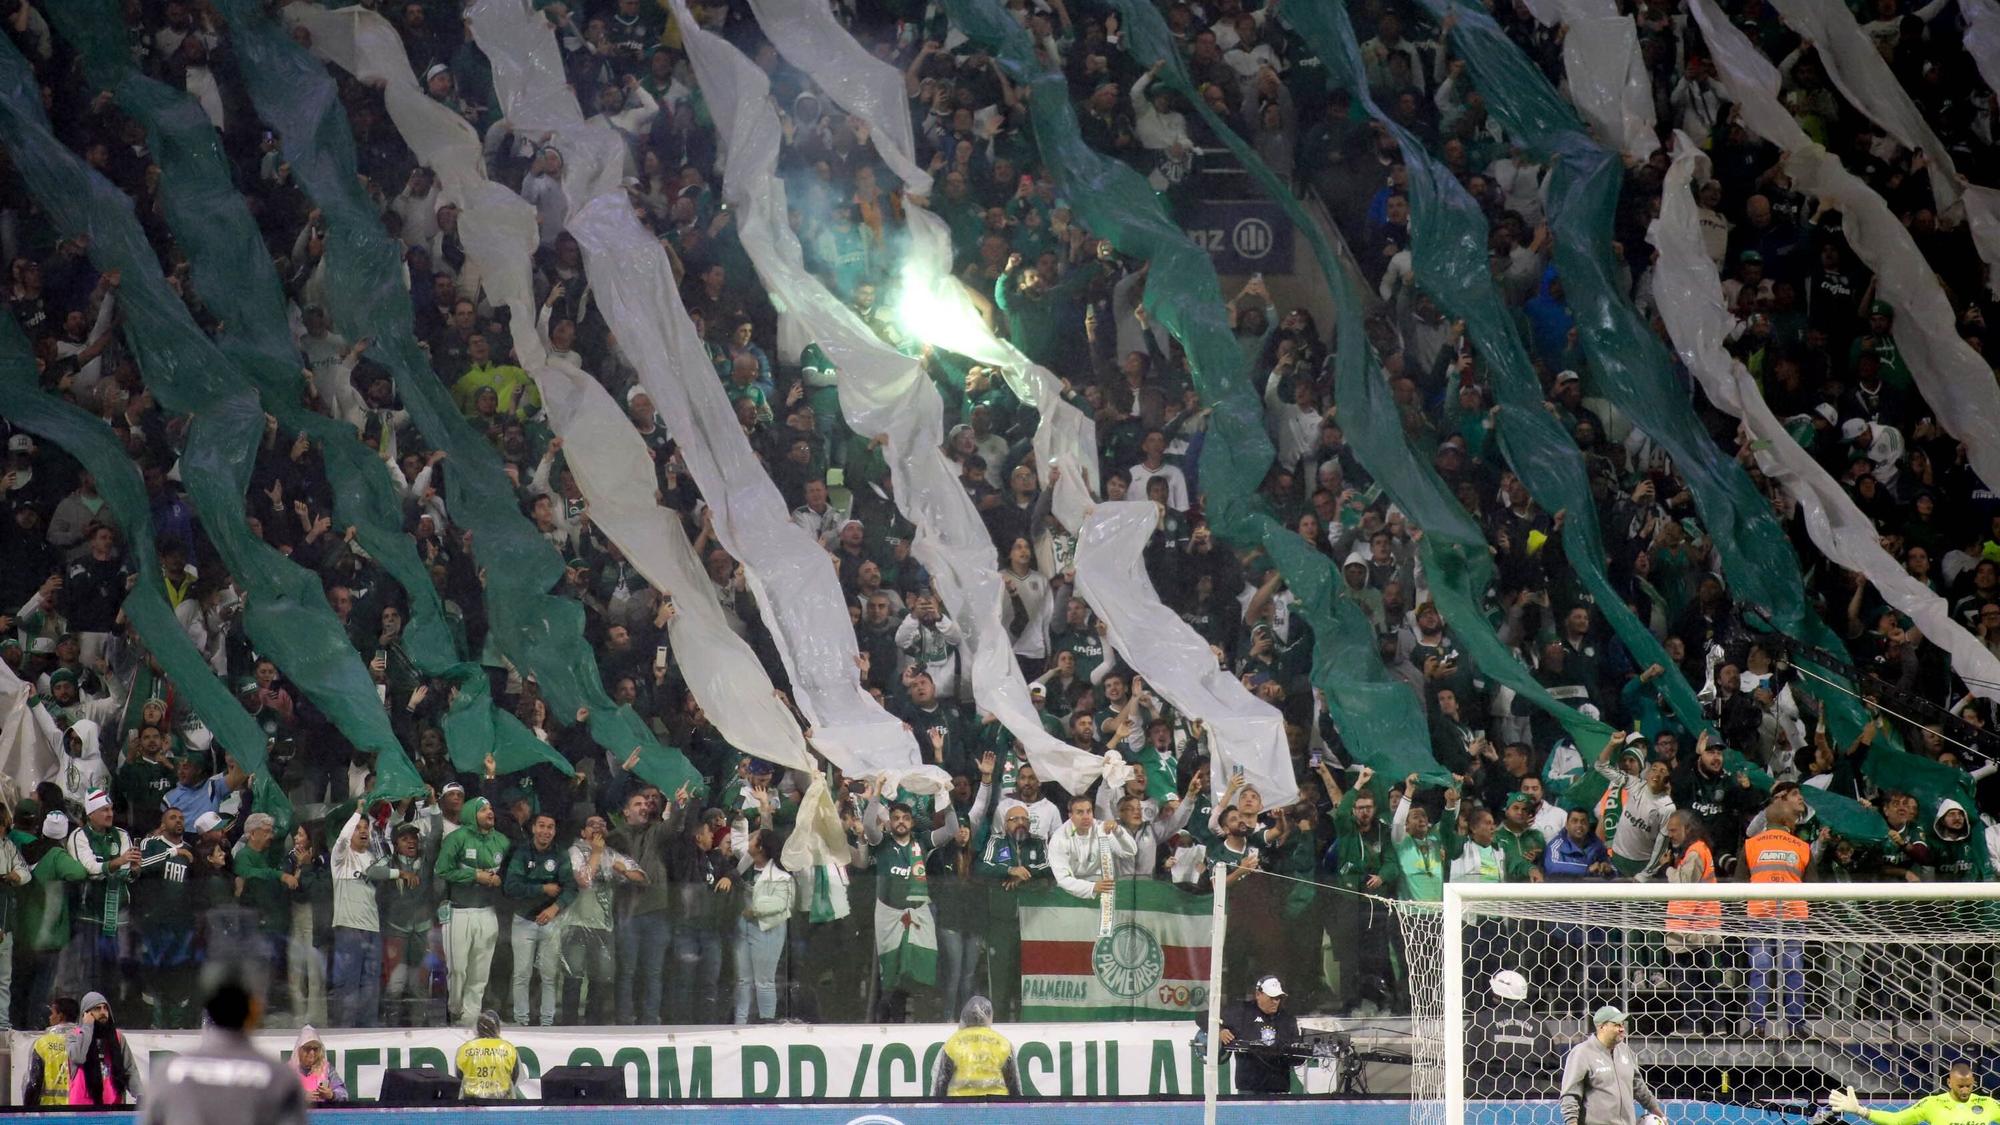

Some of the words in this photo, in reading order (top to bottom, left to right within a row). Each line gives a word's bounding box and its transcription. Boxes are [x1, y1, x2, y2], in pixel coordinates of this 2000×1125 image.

[1624, 810, 1652, 832] crefisa
[164, 861, 188, 883] FIAT
[1097, 951, 1159, 997] PALMEIRAS
[1022, 978, 1088, 1000] PALMEIRAS
[476, 1065, 496, 1078] 287
